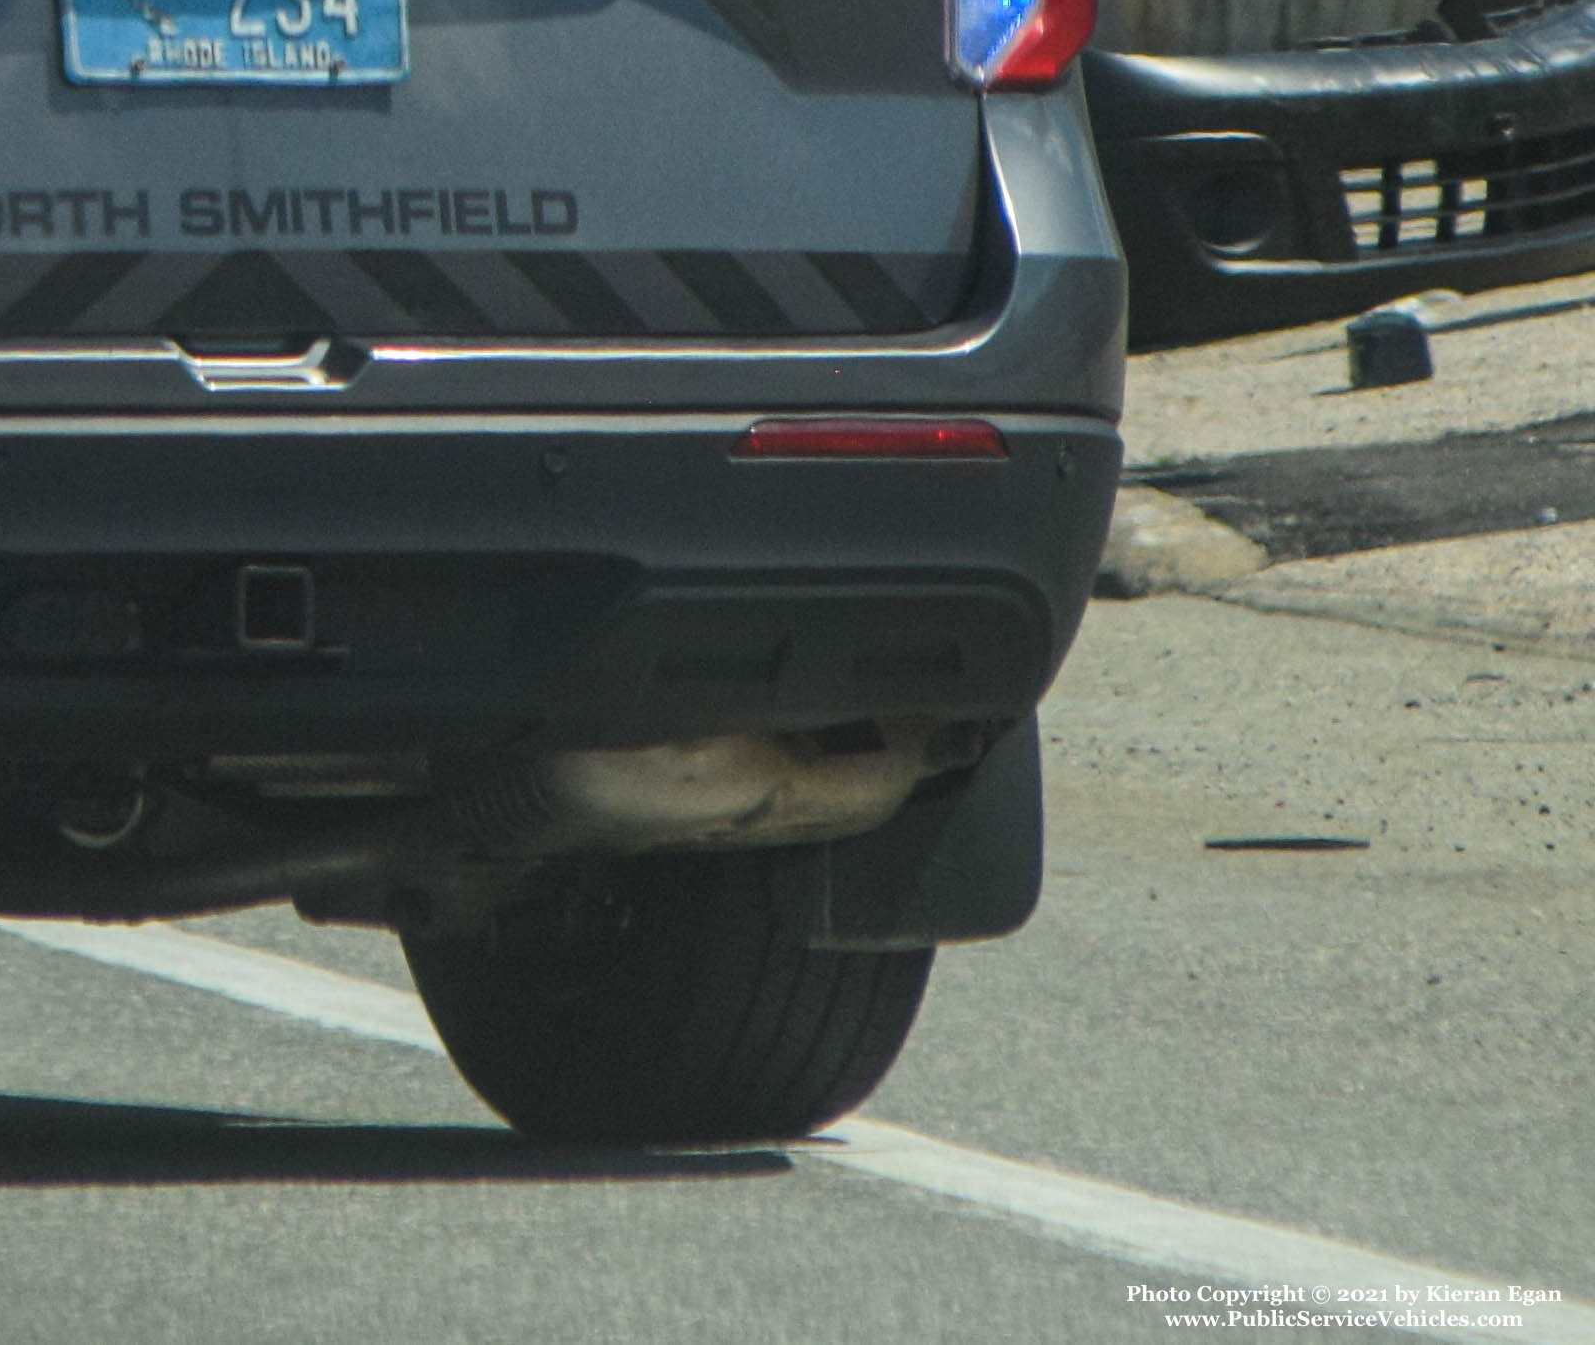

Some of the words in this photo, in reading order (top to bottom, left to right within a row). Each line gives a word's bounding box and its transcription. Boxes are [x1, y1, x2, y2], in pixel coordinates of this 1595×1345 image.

[147, 36, 224, 68] RHODE
[242, 36, 331, 69] ISLAND
[178, 189, 579, 237] SMITHFIELD
